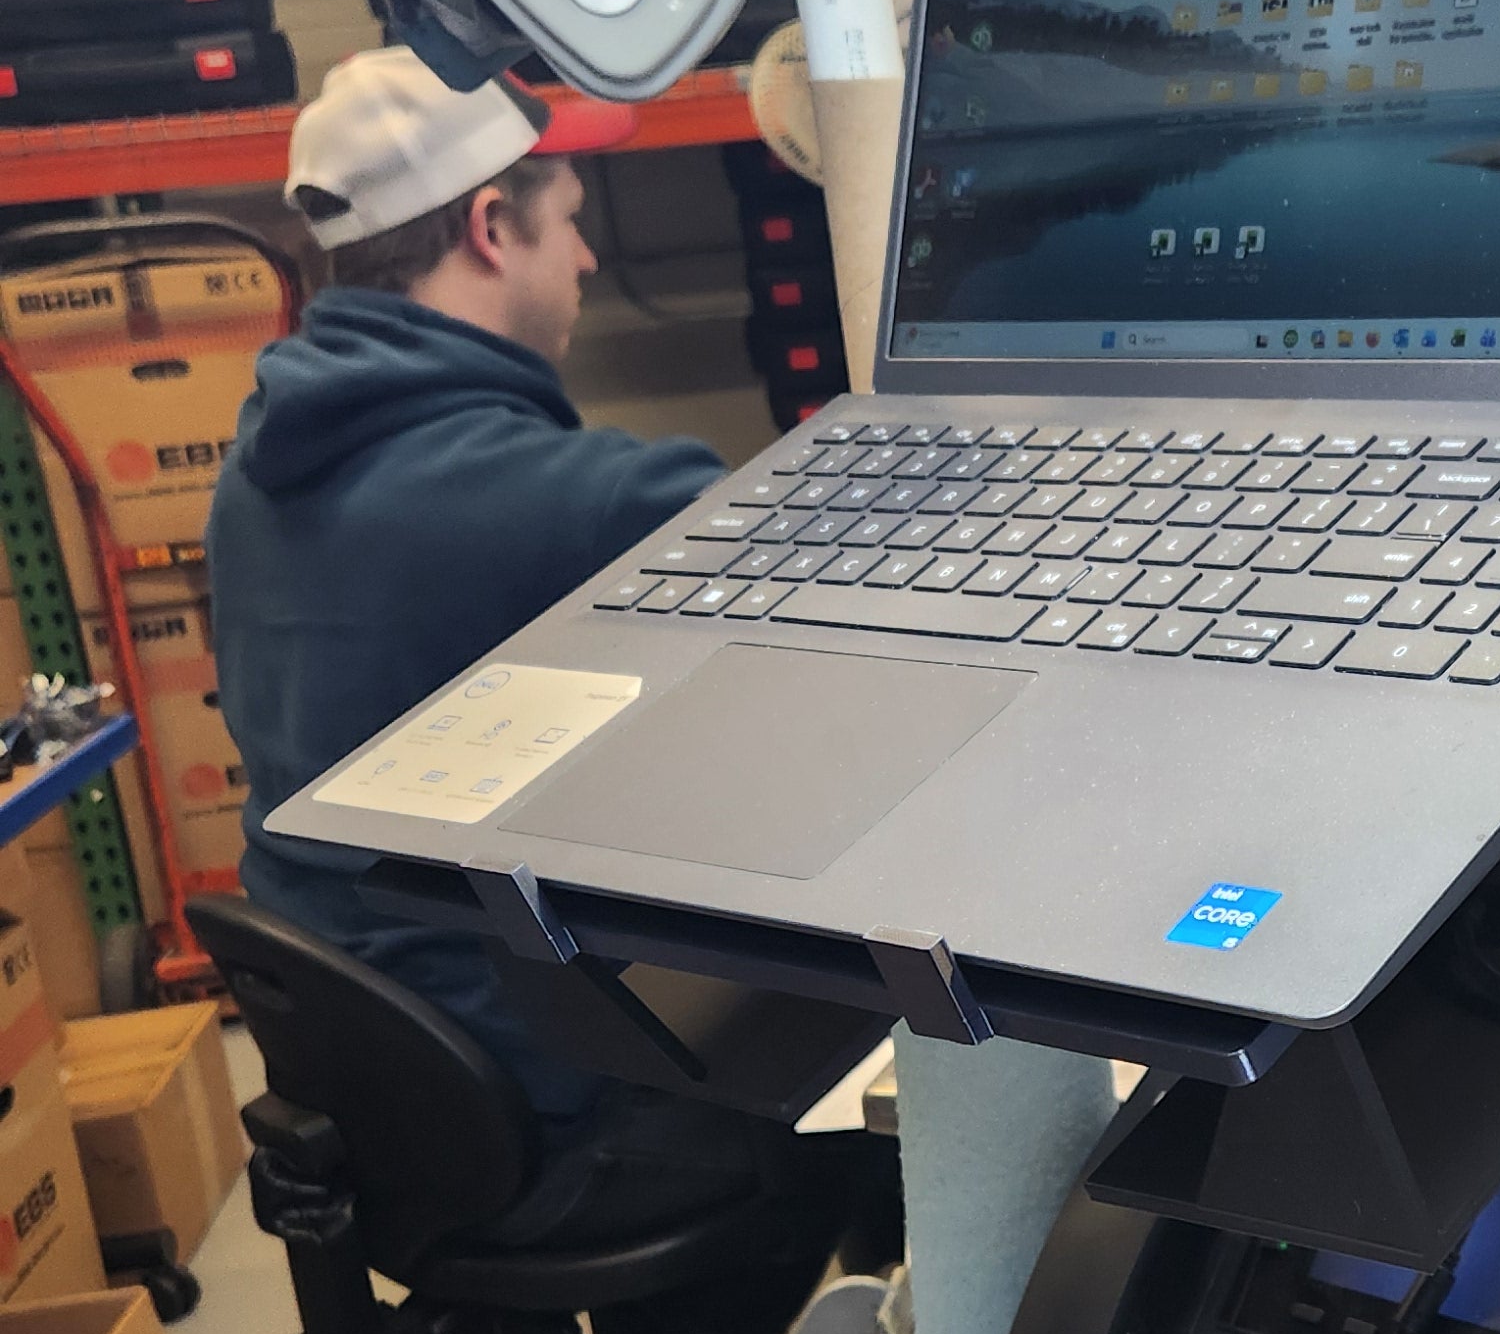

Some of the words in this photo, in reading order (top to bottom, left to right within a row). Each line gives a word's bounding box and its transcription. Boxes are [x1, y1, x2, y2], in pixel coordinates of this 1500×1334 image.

[1438, 473, 1491, 484] backspace
[897, 490, 912, 501] E
[942, 491, 957, 502] R
[992, 493, 1007, 503] T
[1041, 495, 1056, 506] Y
[1091, 497, 1106, 508] U
[1250, 504, 1267, 514] P
[819, 522, 834, 532] S
[864, 524, 879, 534] D
[911, 525, 927, 536] F
[1008, 530, 1025, 542] H
[1060, 533, 1076, 544] J
[1112, 536, 1129, 547] K
[1166, 539, 1179, 550] L
[1383, 553, 1414, 561] enter
[1449, 557, 1463, 567] 4
[938, 566, 955, 578] B
[989, 569, 1008, 581] N
[1040, 572, 1061, 585] M
[1343, 594, 1370, 604] shift
[1463, 603, 1478, 615] 2
[1393, 646, 1408, 657] 0
